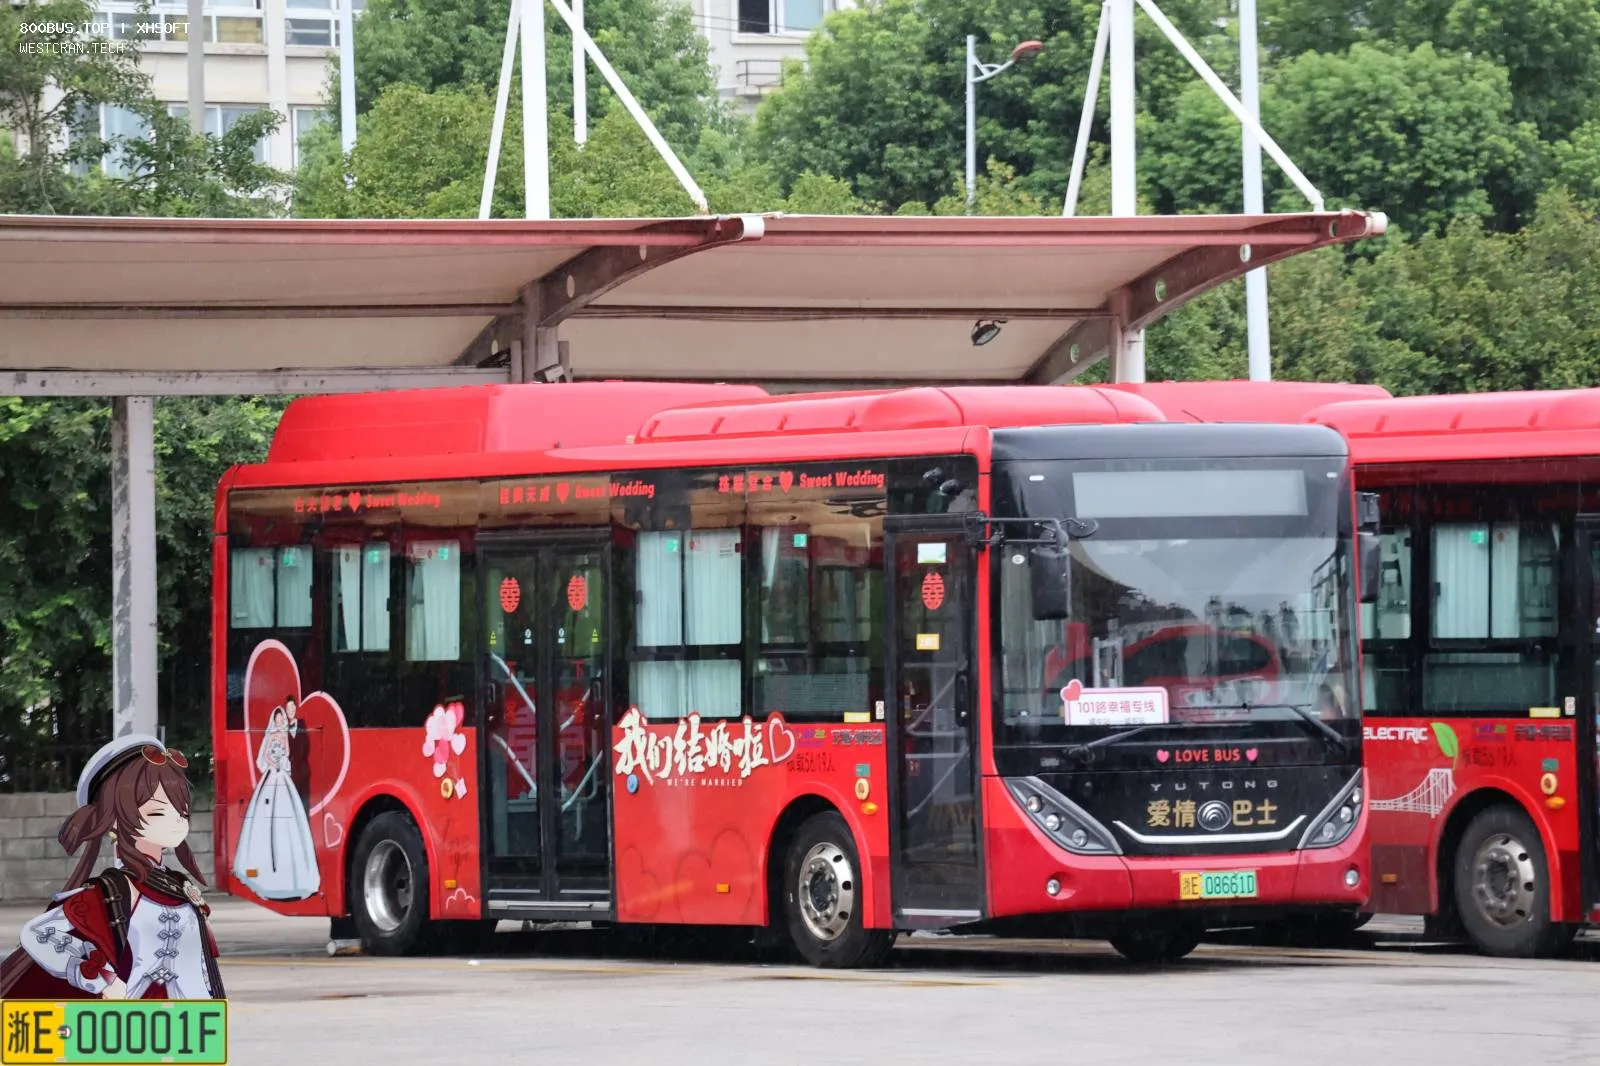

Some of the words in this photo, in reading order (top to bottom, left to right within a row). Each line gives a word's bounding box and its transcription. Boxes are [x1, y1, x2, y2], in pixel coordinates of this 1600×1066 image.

[800, 473, 832, 488] Sweet
[835, 469, 885, 489] Wedding
[609, 480, 655, 499] Wedding
[613, 707, 768, 786] 我们结婚啦
[1175, 749, 1209, 762] LOVE
[1214, 749, 1241, 762] BUS
[701, 778, 744, 787] MARRIED
[1151, 780, 1279, 792] YUTONG
[1147, 799, 1197, 828] 爱情
[1232, 798, 1278, 827] 巴士
